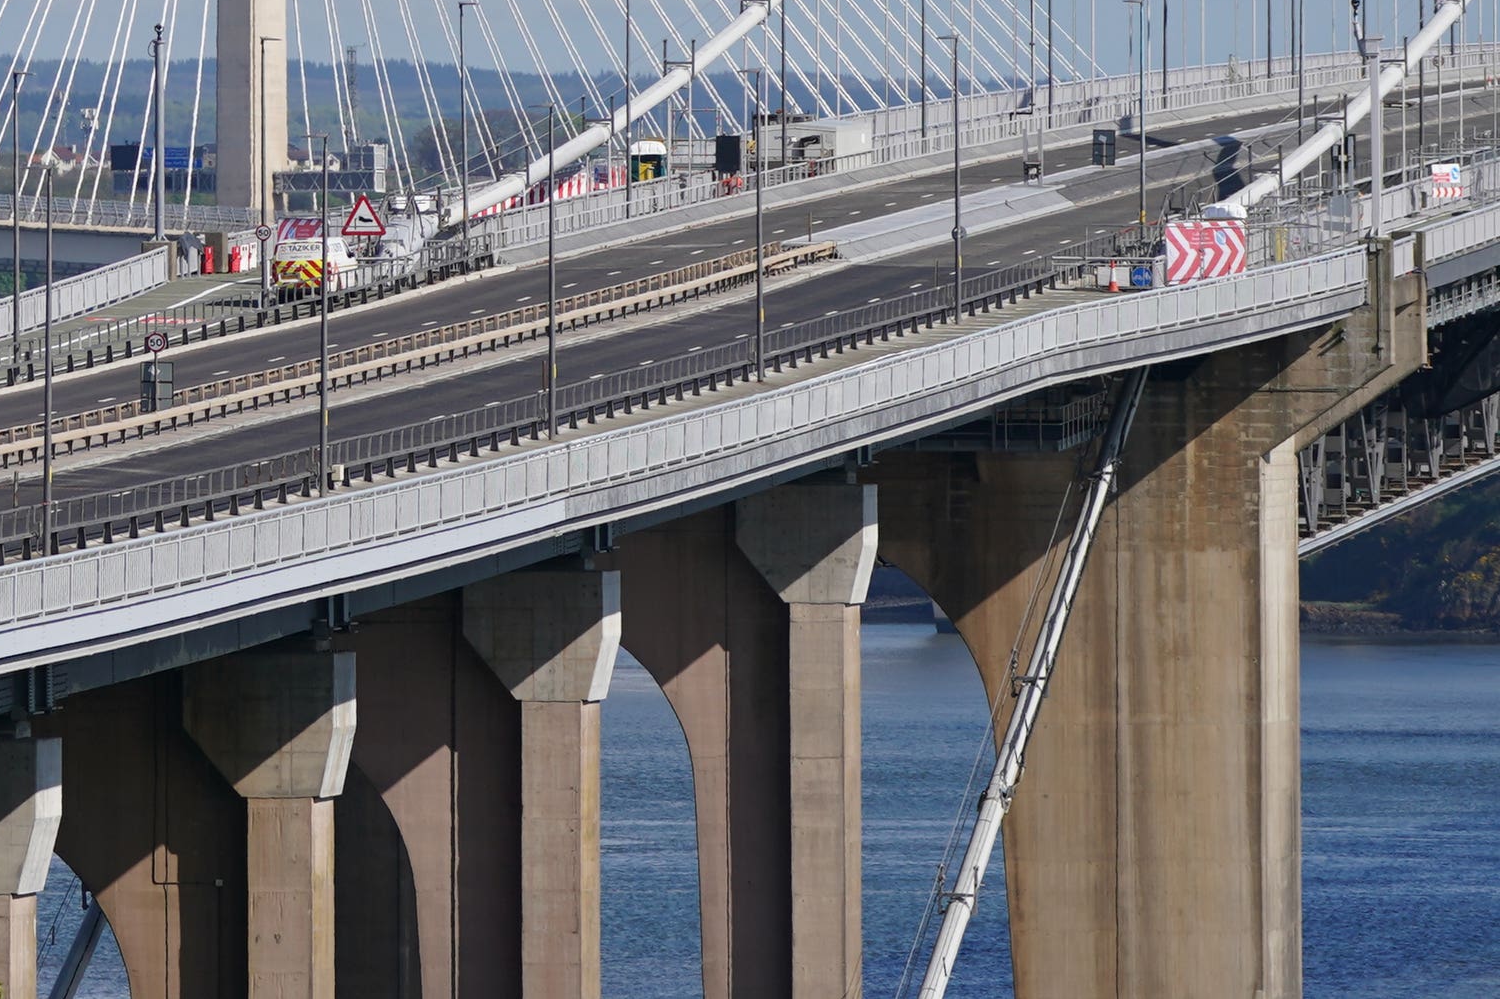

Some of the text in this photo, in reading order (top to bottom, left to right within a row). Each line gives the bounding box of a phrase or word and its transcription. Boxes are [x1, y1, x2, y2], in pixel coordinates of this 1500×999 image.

[258, 229, 269, 237] 50
[289, 244, 320, 252] TAZIKER
[150, 338, 162, 347] 50
